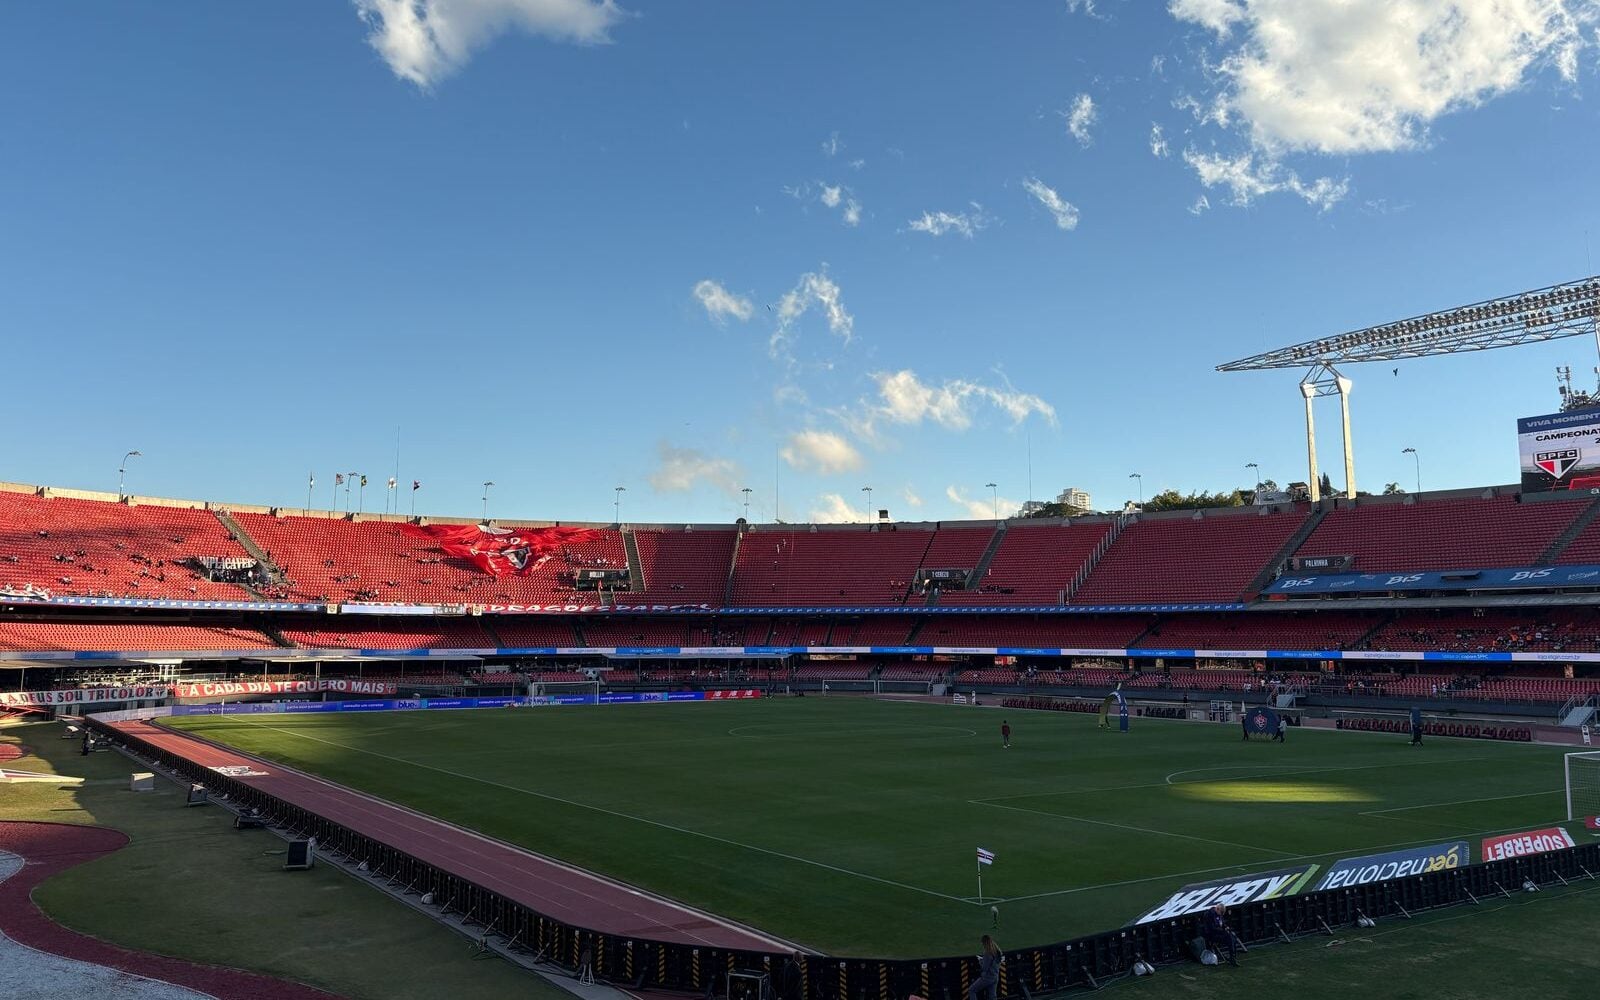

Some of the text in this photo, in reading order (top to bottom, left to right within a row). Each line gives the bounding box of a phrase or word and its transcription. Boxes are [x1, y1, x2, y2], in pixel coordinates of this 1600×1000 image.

[1526, 419, 1551, 428] VIVA
[1538, 450, 1576, 460] SPFC
[20, 692, 53, 704] DEUS
[57, 691, 83, 702] SOU
[88, 688, 153, 700] TRICOLOR
[189, 679, 384, 697] A CADA DIA TE QUERO MAIS
[1486, 834, 1564, 861] SUPERBET
